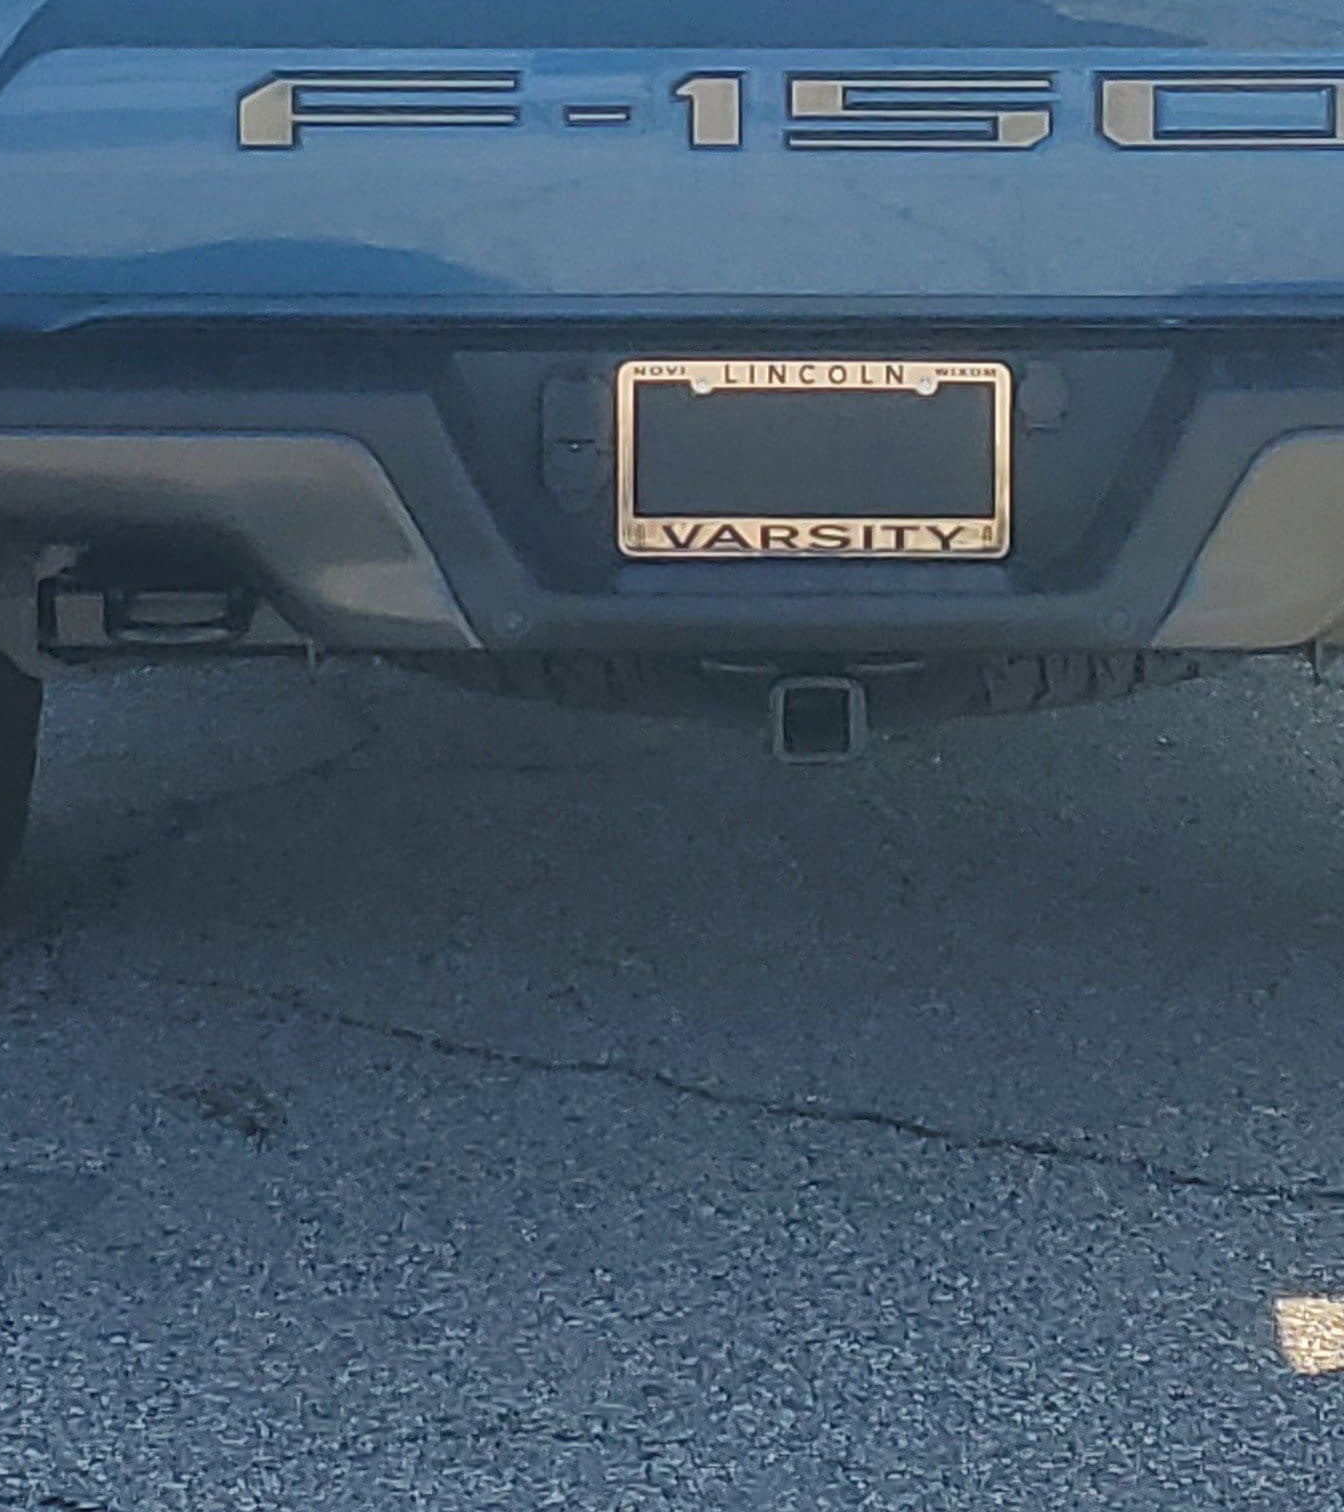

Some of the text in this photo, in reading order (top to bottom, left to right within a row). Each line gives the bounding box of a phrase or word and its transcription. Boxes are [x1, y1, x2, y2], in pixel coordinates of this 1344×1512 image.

[633, 365, 686, 377] NOVI
[724, 364, 904, 385] LINCOLN
[662, 524, 962, 551] VARSITY
